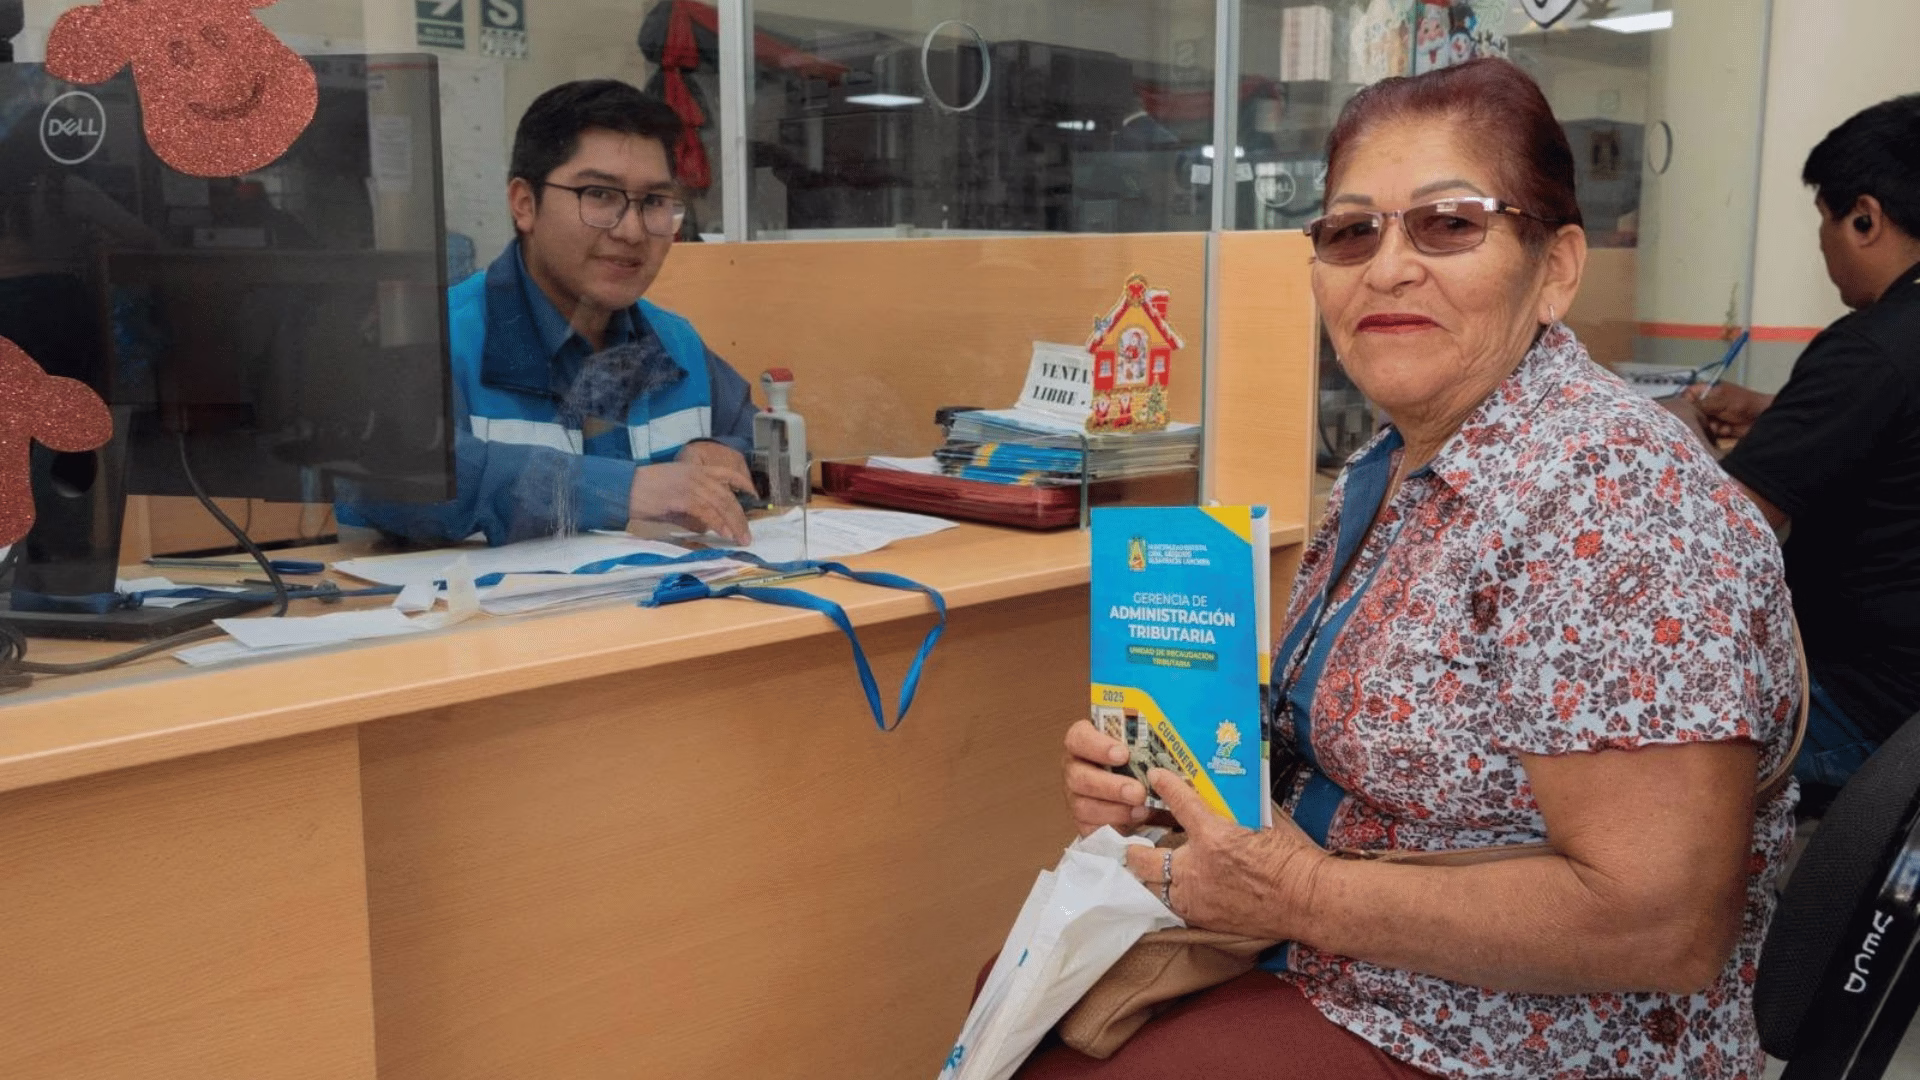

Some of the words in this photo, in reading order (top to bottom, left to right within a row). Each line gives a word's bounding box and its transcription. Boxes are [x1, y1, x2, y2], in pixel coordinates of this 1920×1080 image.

[48, 118, 99, 137] DELL
[1133, 591, 1190, 606] GERENCIA
[1192, 594, 1208, 607] DE
[1109, 605, 1236, 627] ADMINISTRACIÓN
[1127, 623, 1217, 645] TRIBUTARIA
[1103, 689, 1125, 703] 2025
[1157, 721, 1199, 779] CUPONERA
